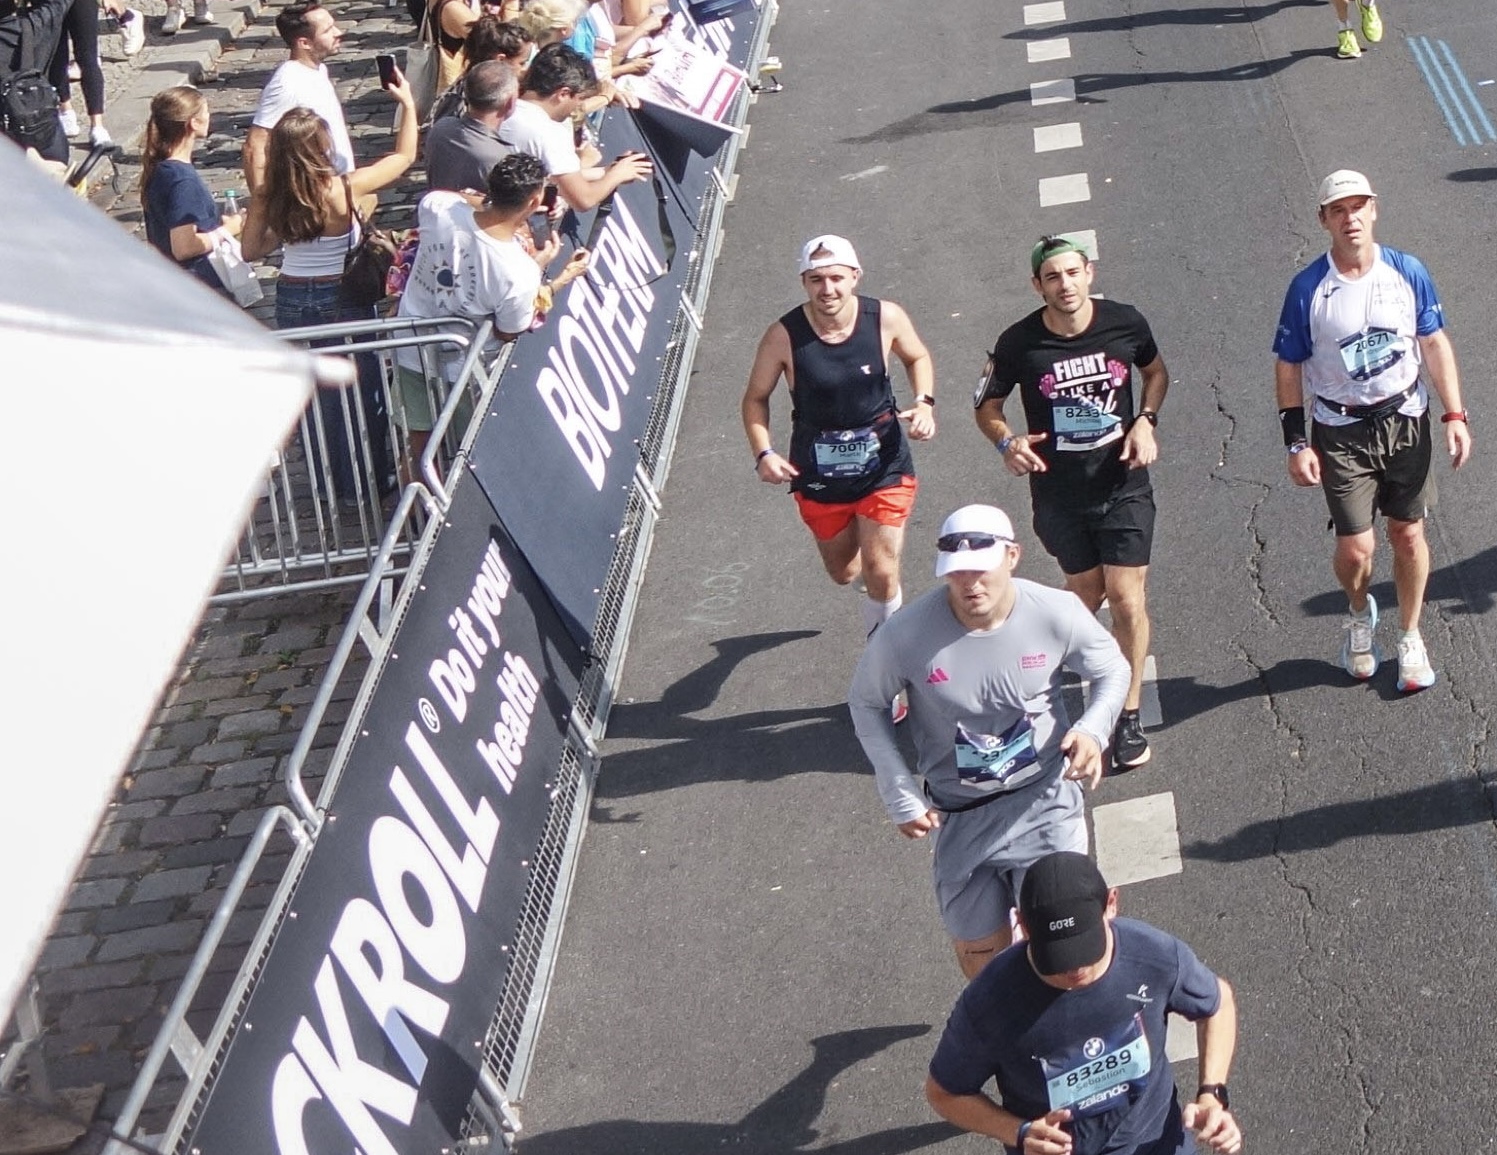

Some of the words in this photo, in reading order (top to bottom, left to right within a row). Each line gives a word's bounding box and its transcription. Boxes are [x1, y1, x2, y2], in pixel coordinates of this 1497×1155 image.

[535, 191, 663, 491] BIOTHERM
[1053, 351, 1107, 382] FIGHT
[1101, 381, 1110, 391] A
[466, 537, 514, 650] your
[448, 606, 488, 656] it
[429, 648, 478, 724] Do
[476, 650, 541, 794] health
[1049, 916, 1076, 932] GORE
[1066, 1048, 1133, 1088] 83289
[1075, 1066, 1126, 1092] Sebastian
[1078, 1082, 1130, 1111] zalando
